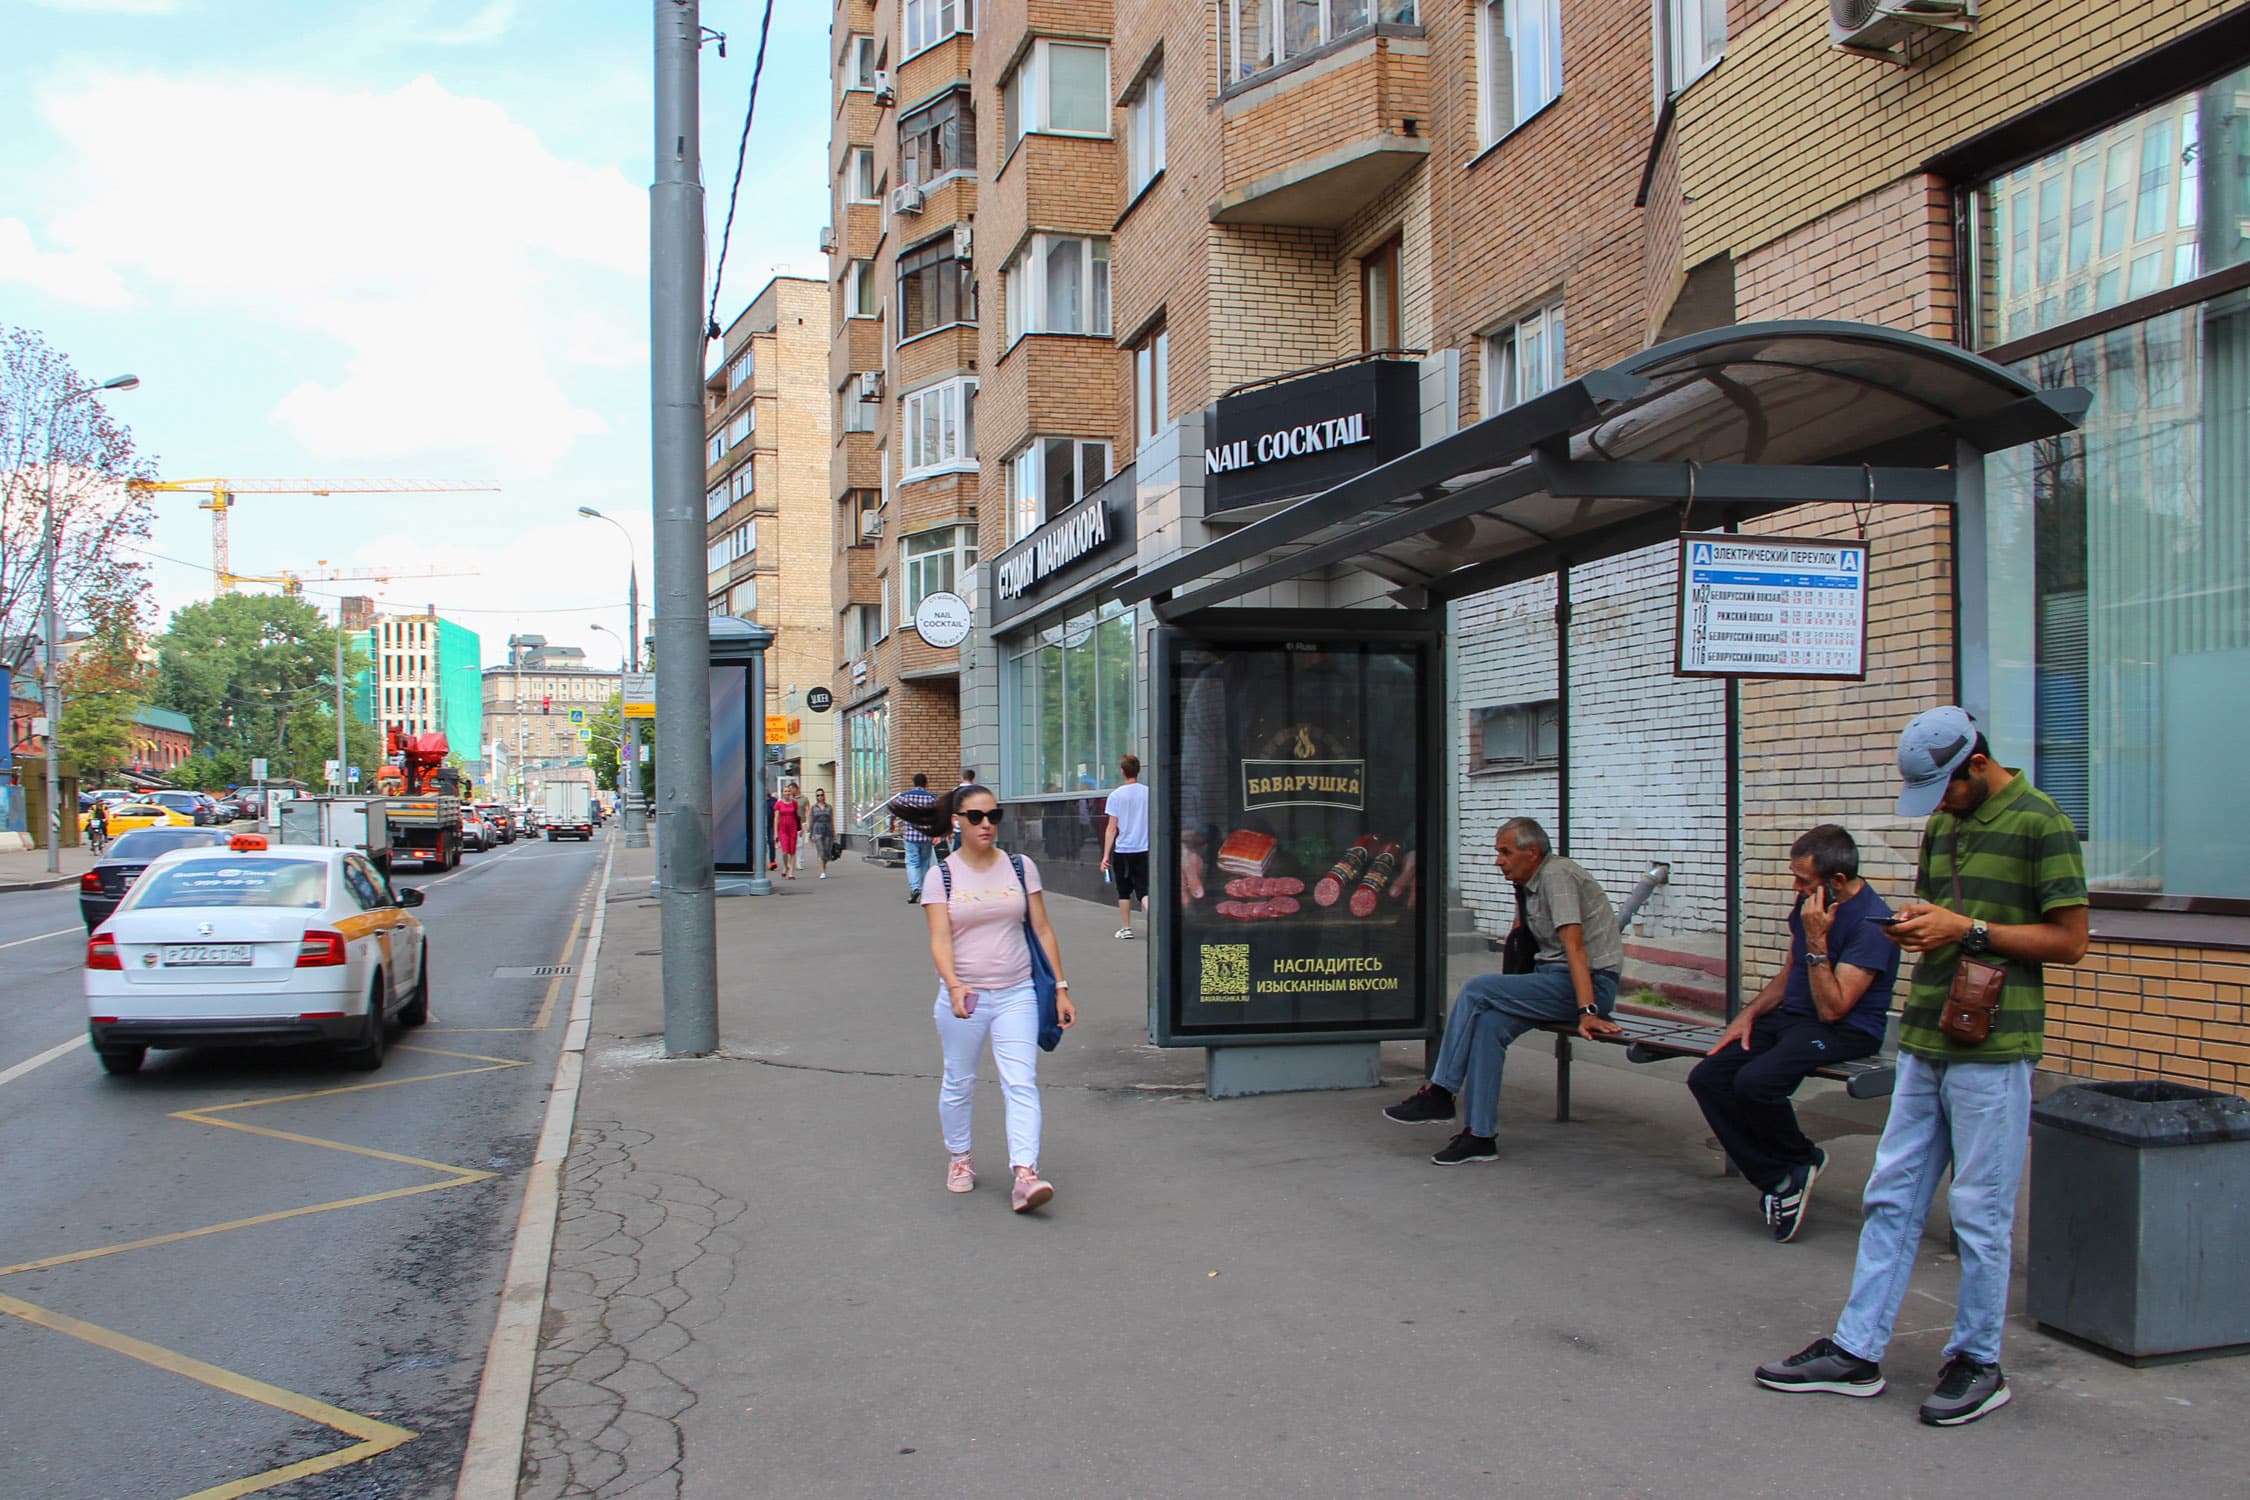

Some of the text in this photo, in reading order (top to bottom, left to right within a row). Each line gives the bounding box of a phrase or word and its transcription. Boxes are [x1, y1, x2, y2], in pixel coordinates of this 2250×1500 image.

[1205, 412, 1371, 475] NAIL COCKTAIL
[998, 500, 1106, 600] СТУДИЯ МАНИКЮРА
[1713, 547, 1837, 565] ЭЛЕКТРИЧЕСКИЙ ПЕРЕУЛОК
[1711, 590, 1755, 601] БЕЛОРУССКИЙ
[1757, 592, 1781, 602] ВОКЗАЛ
[934, 611, 953, 619] NAIL
[1749, 612, 1773, 622] ВОКЗАЛ
[923, 620, 964, 628] COCKTAIL
[1709, 631, 1753, 642] БЕЛОРУССКИЙ
[1755, 633, 1779, 643] ВОКЗАЛ
[1707, 651, 1752, 662] БЕЛОРУССКИЙ
[1754, 653, 1778, 663] ВОКЗАЛ
[1247, 775, 1361, 795] БАВАРУШКА
[1273, 957, 1383, 975] НАСЛАДИТЕСЬ
[1256, 977, 1399, 993] ИЗЫСКАННЫМ ВКУСОМ
